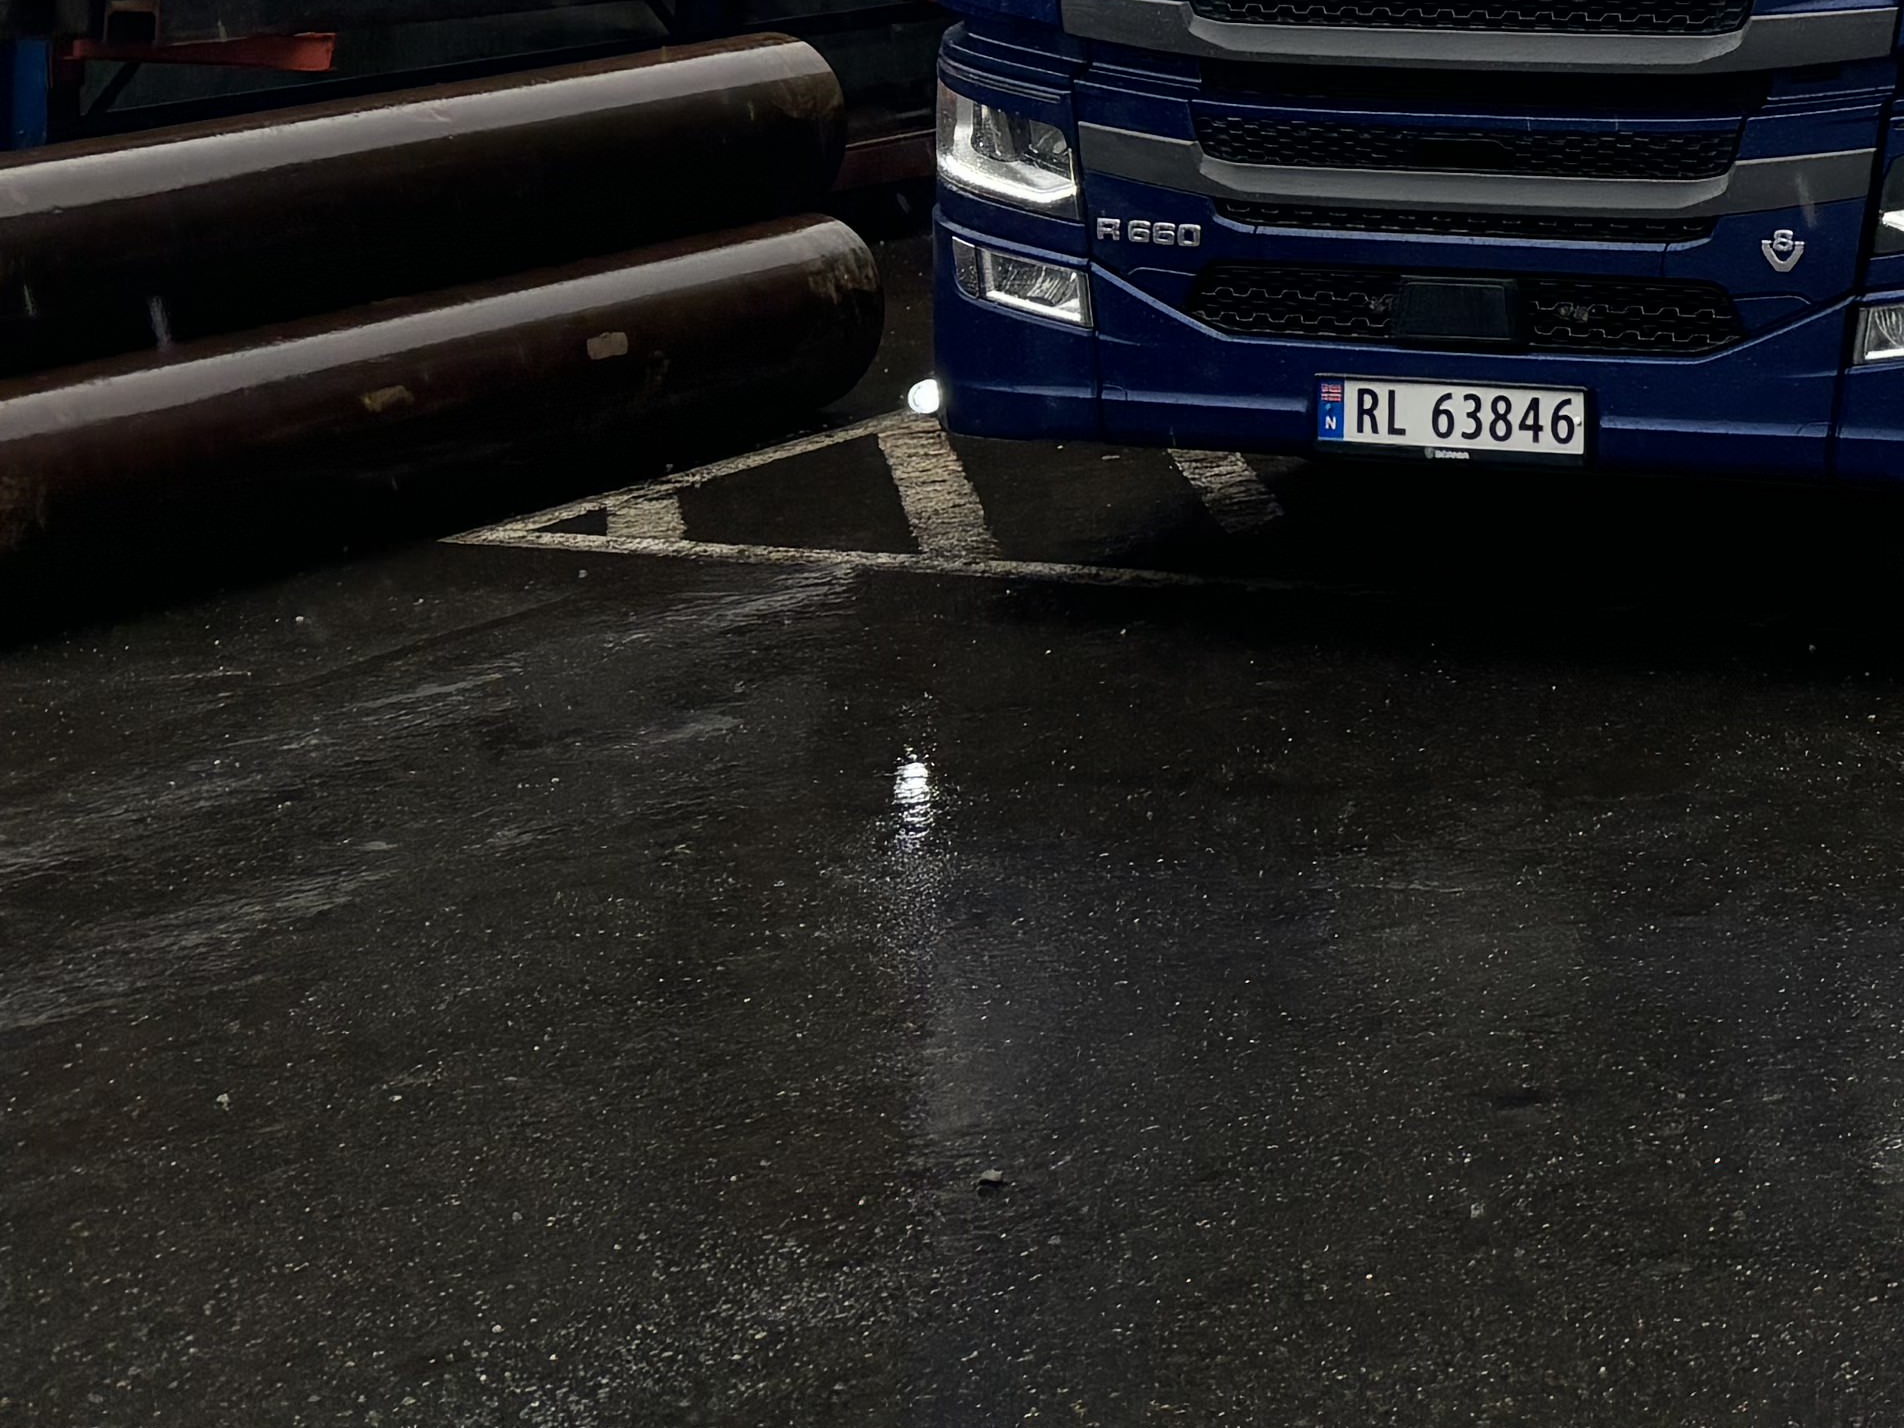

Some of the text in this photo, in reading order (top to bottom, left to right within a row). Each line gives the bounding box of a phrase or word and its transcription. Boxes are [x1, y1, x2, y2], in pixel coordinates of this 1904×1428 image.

[1096, 217, 1202, 247] R 660
[1325, 416, 1337, 431] N
[1356, 387, 1576, 445] RL 63846
